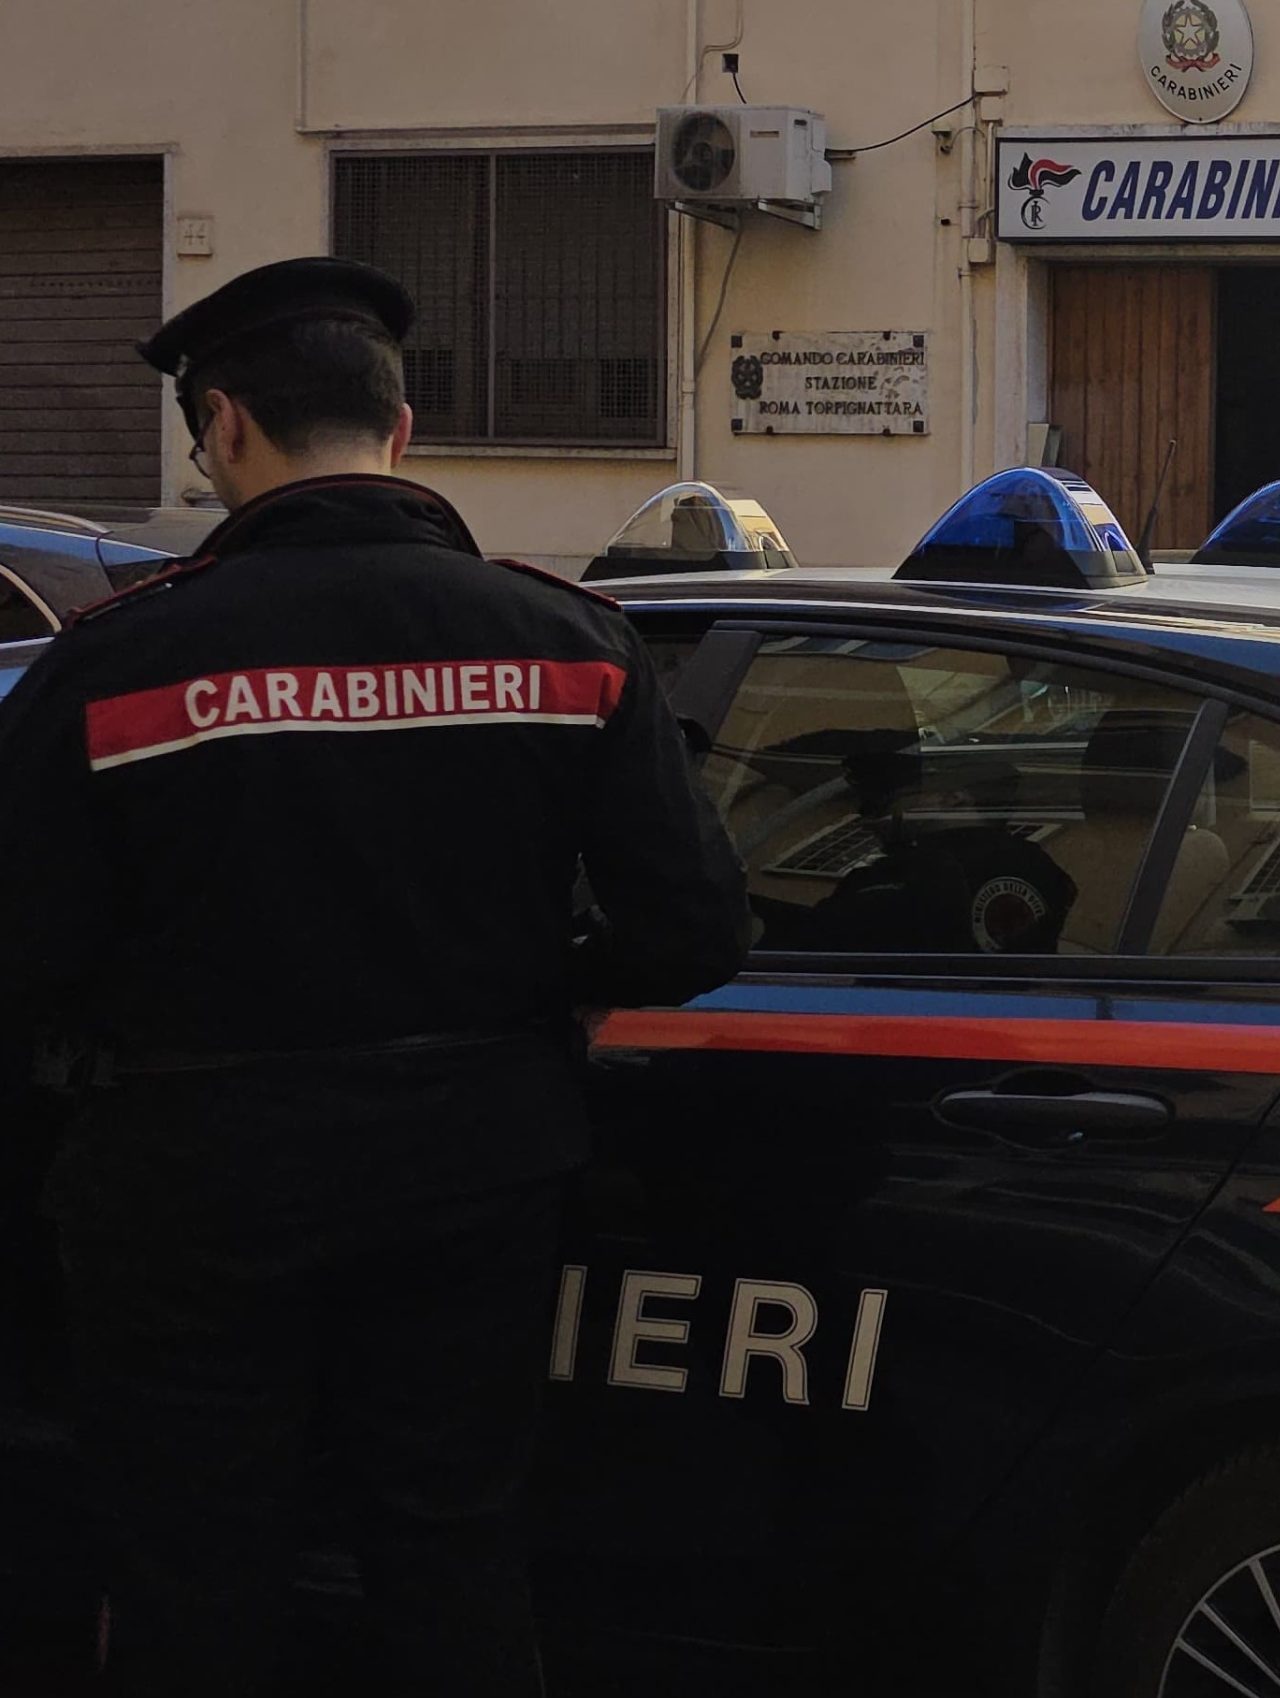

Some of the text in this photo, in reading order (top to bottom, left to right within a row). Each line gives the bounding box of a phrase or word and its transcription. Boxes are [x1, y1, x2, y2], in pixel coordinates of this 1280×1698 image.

[1150, 63, 1242, 101] CARABINIERI
[759, 351, 925, 366] COMANDO CARABINIERI
[804, 376, 878, 391] STAZIONE
[759, 401, 923, 416] ROMA TORPIGNATTARA
[184, 664, 542, 729] CARABINIERI
